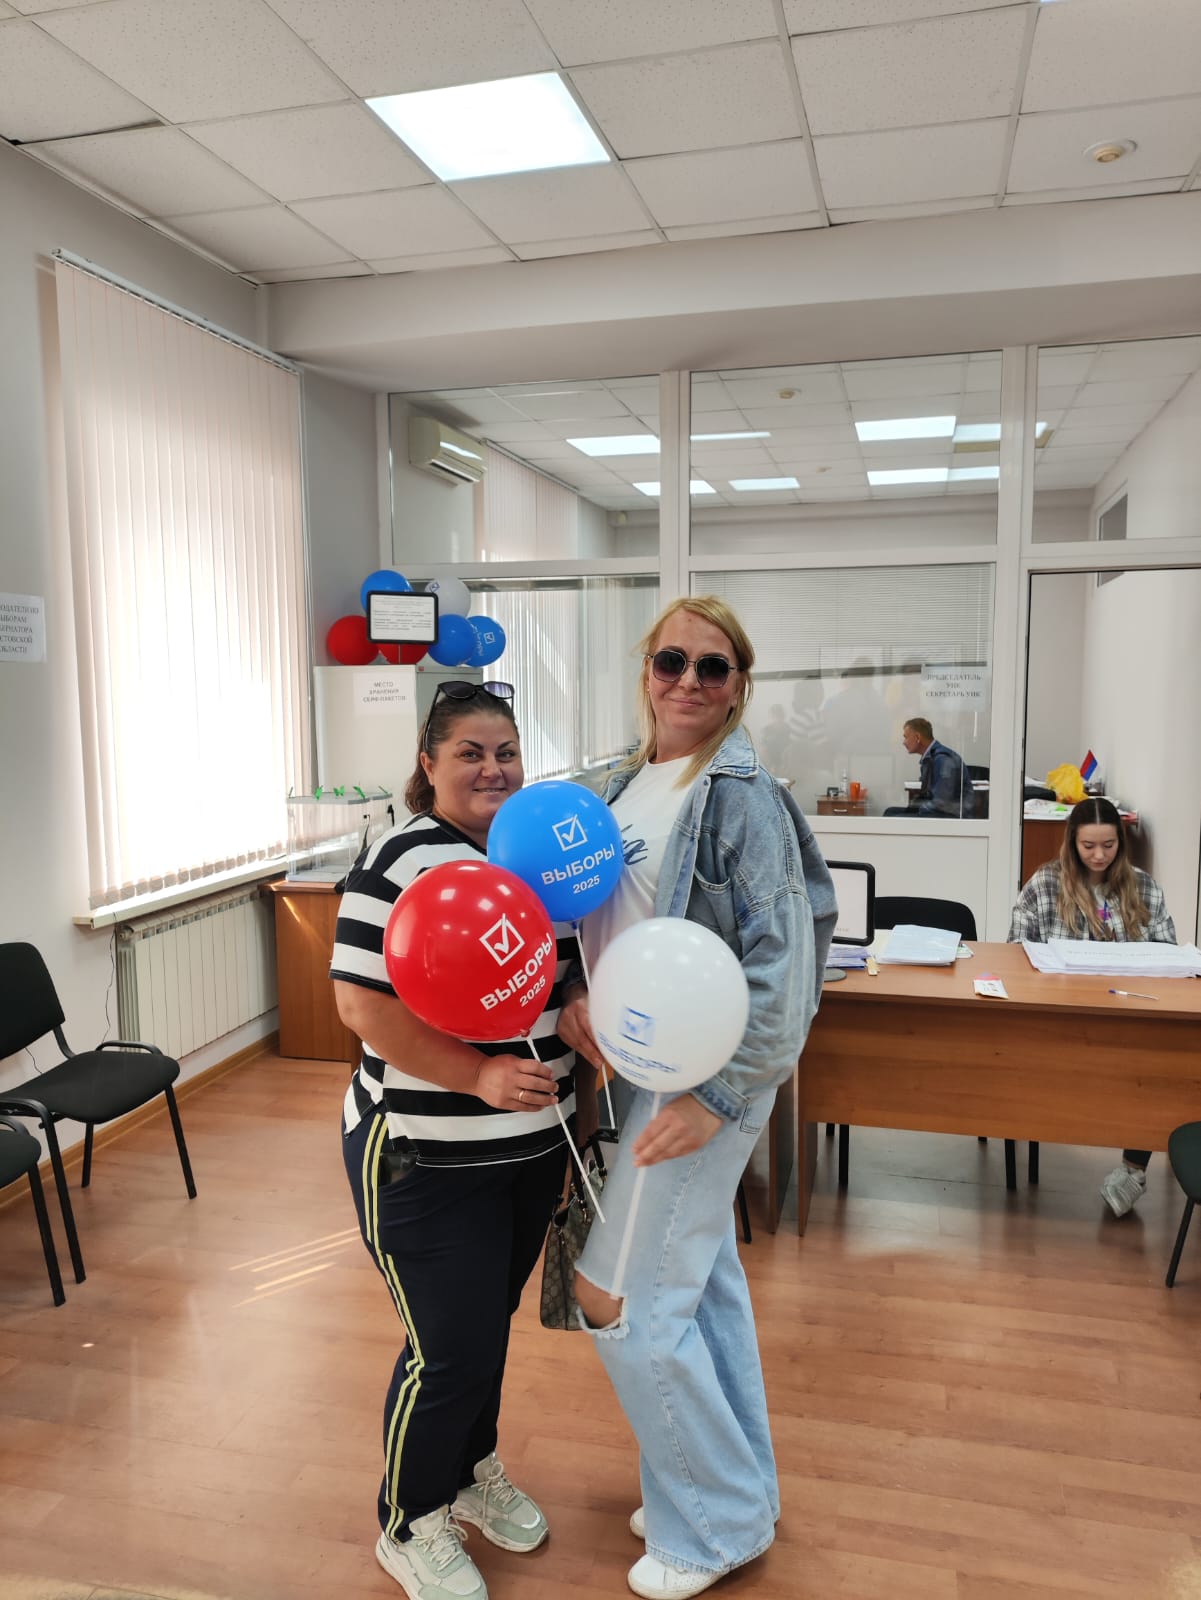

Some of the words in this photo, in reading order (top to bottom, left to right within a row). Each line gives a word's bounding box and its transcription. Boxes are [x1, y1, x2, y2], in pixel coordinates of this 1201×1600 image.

[541, 843, 615, 885] ВЫБОРЫ
[573, 875, 600, 894] 2025
[480, 932, 553, 1010] ВЫБОРЫ
[519, 975, 546, 1007] 2025
